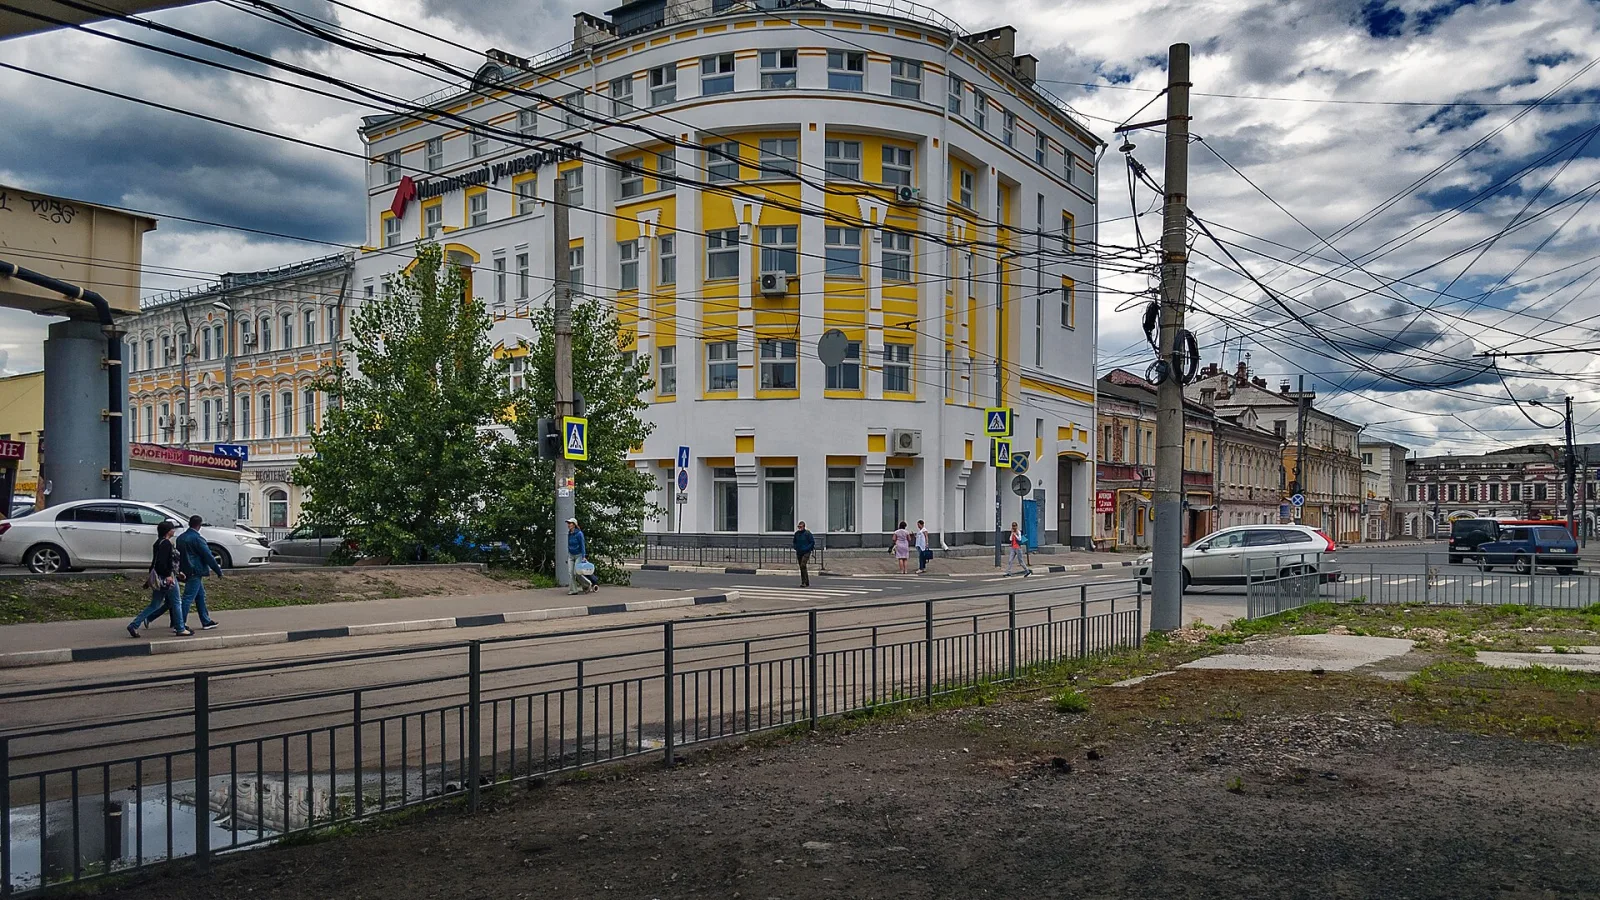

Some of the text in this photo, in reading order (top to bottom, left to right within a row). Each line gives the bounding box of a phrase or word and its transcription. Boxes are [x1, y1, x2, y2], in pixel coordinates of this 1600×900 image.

[417, 141, 583, 200] Мининский университет
[0, 442, 20, 457] IE
[132, 446, 238, 468] СЛОЕНЫЙ ПИРОЖОК
